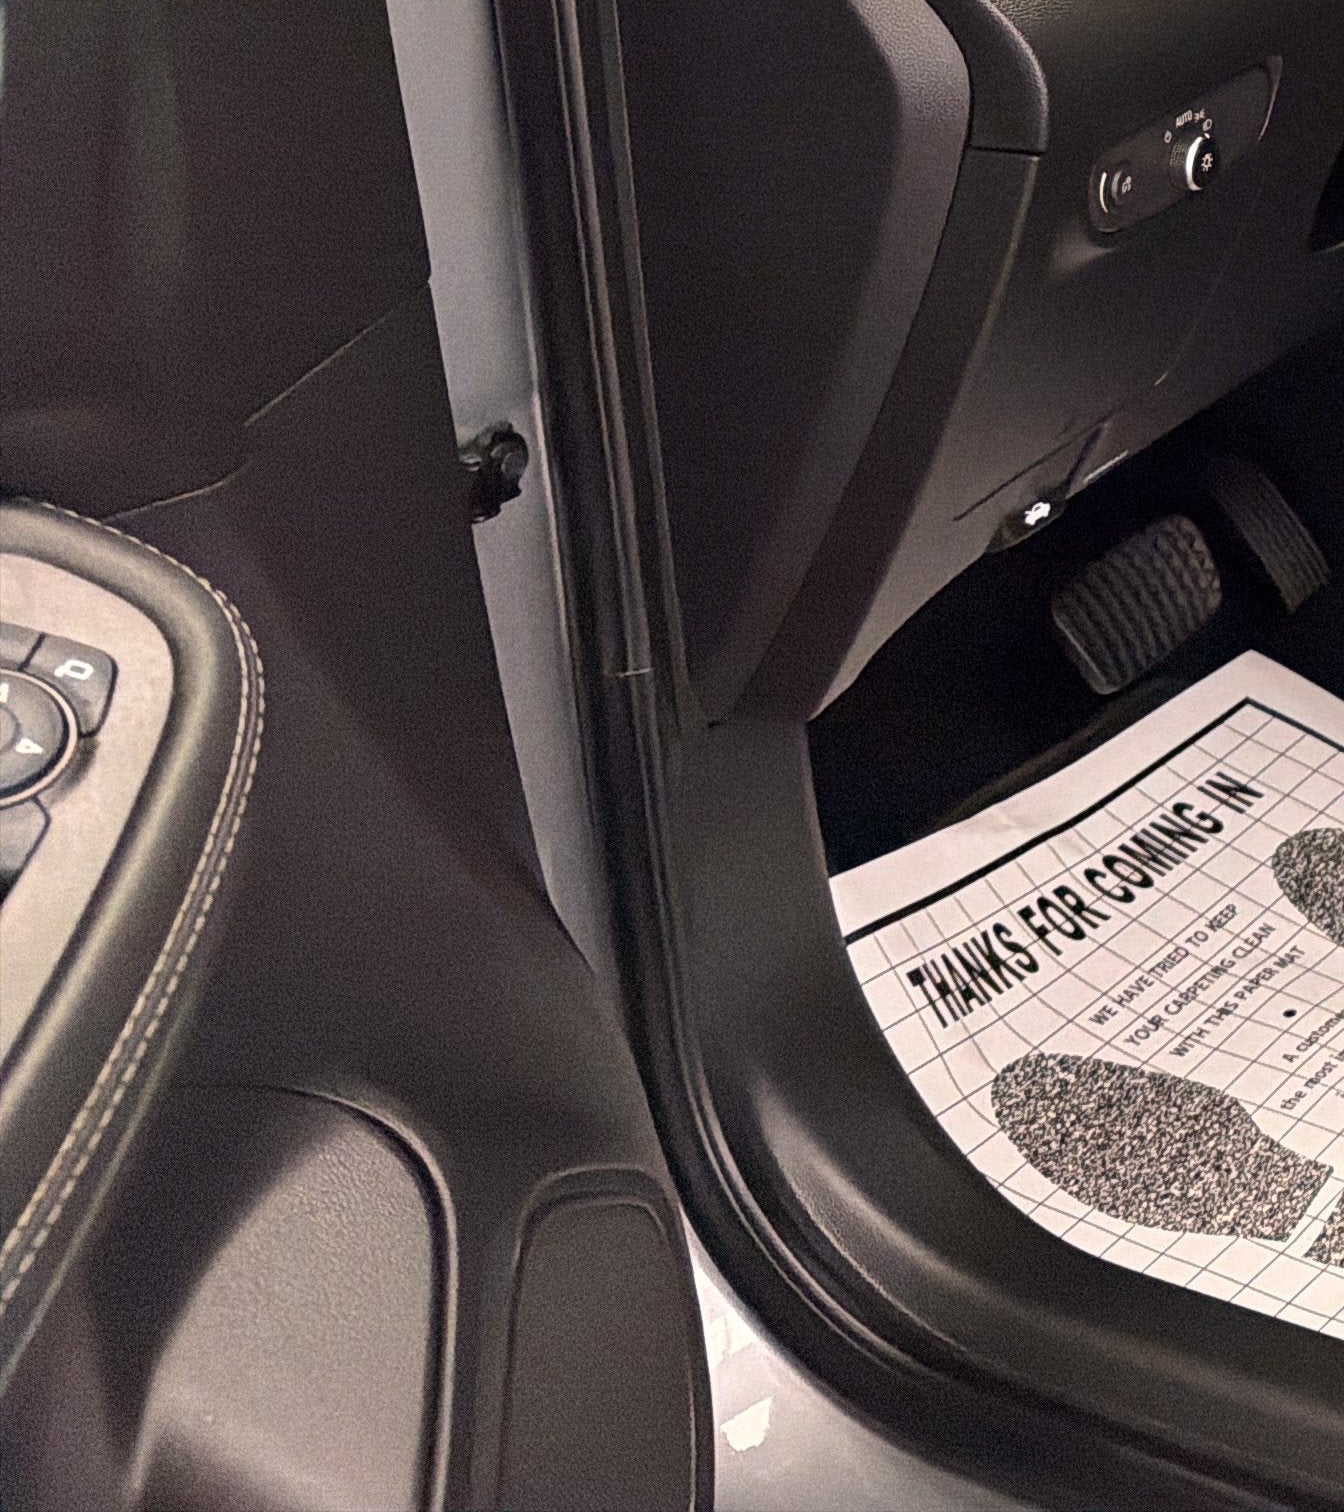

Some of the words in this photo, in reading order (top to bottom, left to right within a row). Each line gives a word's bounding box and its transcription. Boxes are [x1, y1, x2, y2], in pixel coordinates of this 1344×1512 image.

[906, 922, 1039, 1028] THANKS
[1017, 885, 1111, 956] FOR
[1083, 802, 1224, 904] COMING
[1196, 771, 1264, 814] IN
[1089, 1004, 1119, 1026] WE
[1112, 974, 1155, 1007] HAVE
[1149, 946, 1189, 978] TRIED
[1184, 930, 1209, 948] TO
[1205, 903, 1237, 932] KEEP
[1124, 1014, 1169, 1047] YOUR
[1163, 958, 1236, 1016] CARPETING
[1231, 922, 1276, 960] CLEAN
[1168, 1026, 1212, 1058] WITH
[1204, 1001, 1240, 1027] THIS
[1232, 967, 1281, 1001] PAPER
[1273, 944, 1307, 969] MAT
[1280, 1089, 1308, 1111] the
[1304, 1060, 1338, 1089] most
[1281, 1052, 1300, 1064] A
